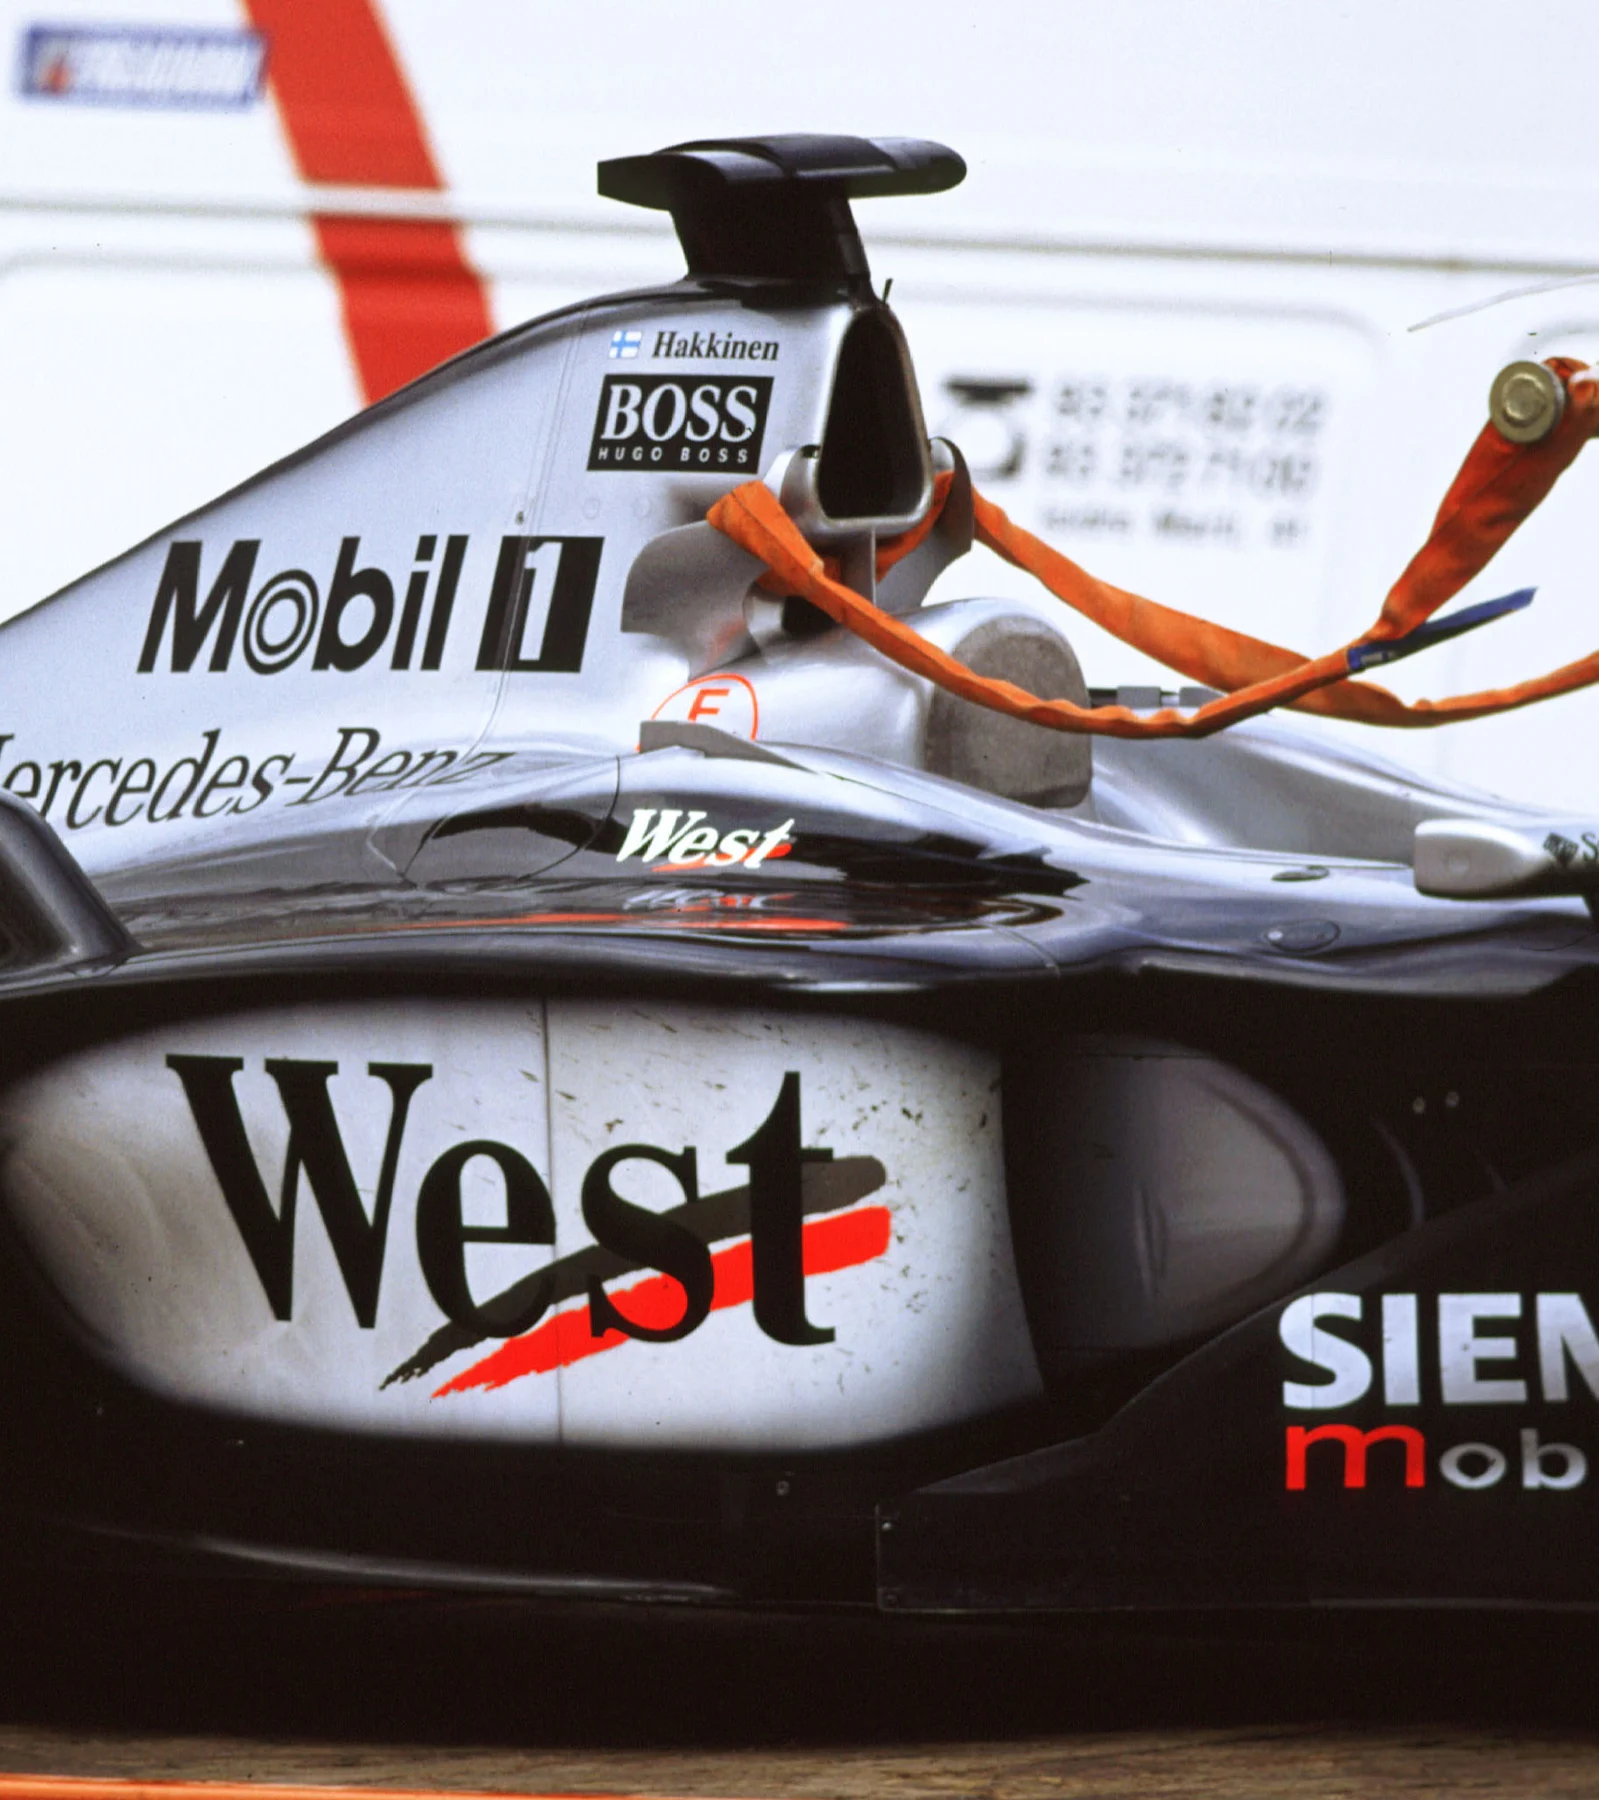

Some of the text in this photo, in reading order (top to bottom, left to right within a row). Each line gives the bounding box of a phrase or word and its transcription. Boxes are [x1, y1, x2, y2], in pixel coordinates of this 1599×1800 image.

[651, 330, 780, 362] Hakkinen
[600, 383, 758, 443] BOSS
[597, 445, 749, 464] HUGO BOSS
[136, 534, 471, 676] Mobil
[615, 808, 795, 869] West
[165, 1053, 837, 1347] West
